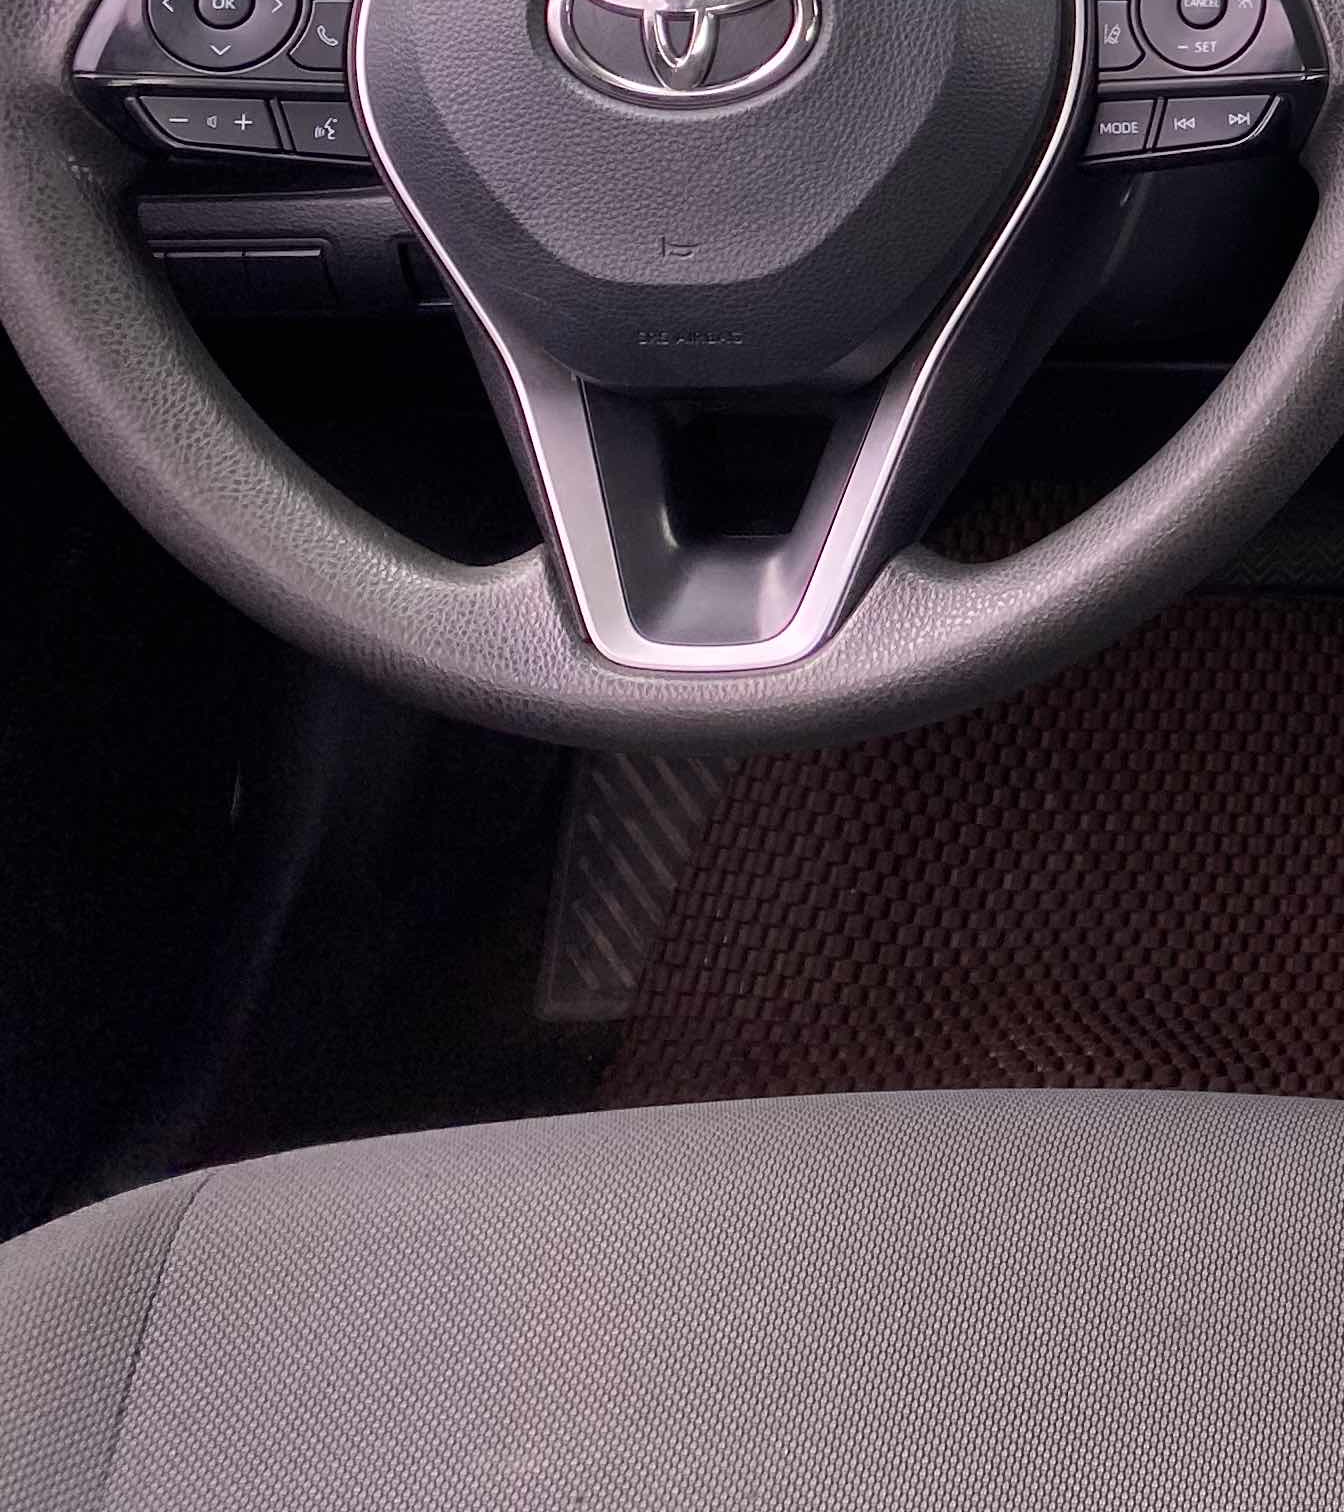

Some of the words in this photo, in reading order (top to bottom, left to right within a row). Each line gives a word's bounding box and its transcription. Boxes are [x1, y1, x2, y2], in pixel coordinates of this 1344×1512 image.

[1183, 0, 1220, 8] CANCEL
[1194, 41, 1217, 53] SET
[1100, 121, 1139, 134] MODE
